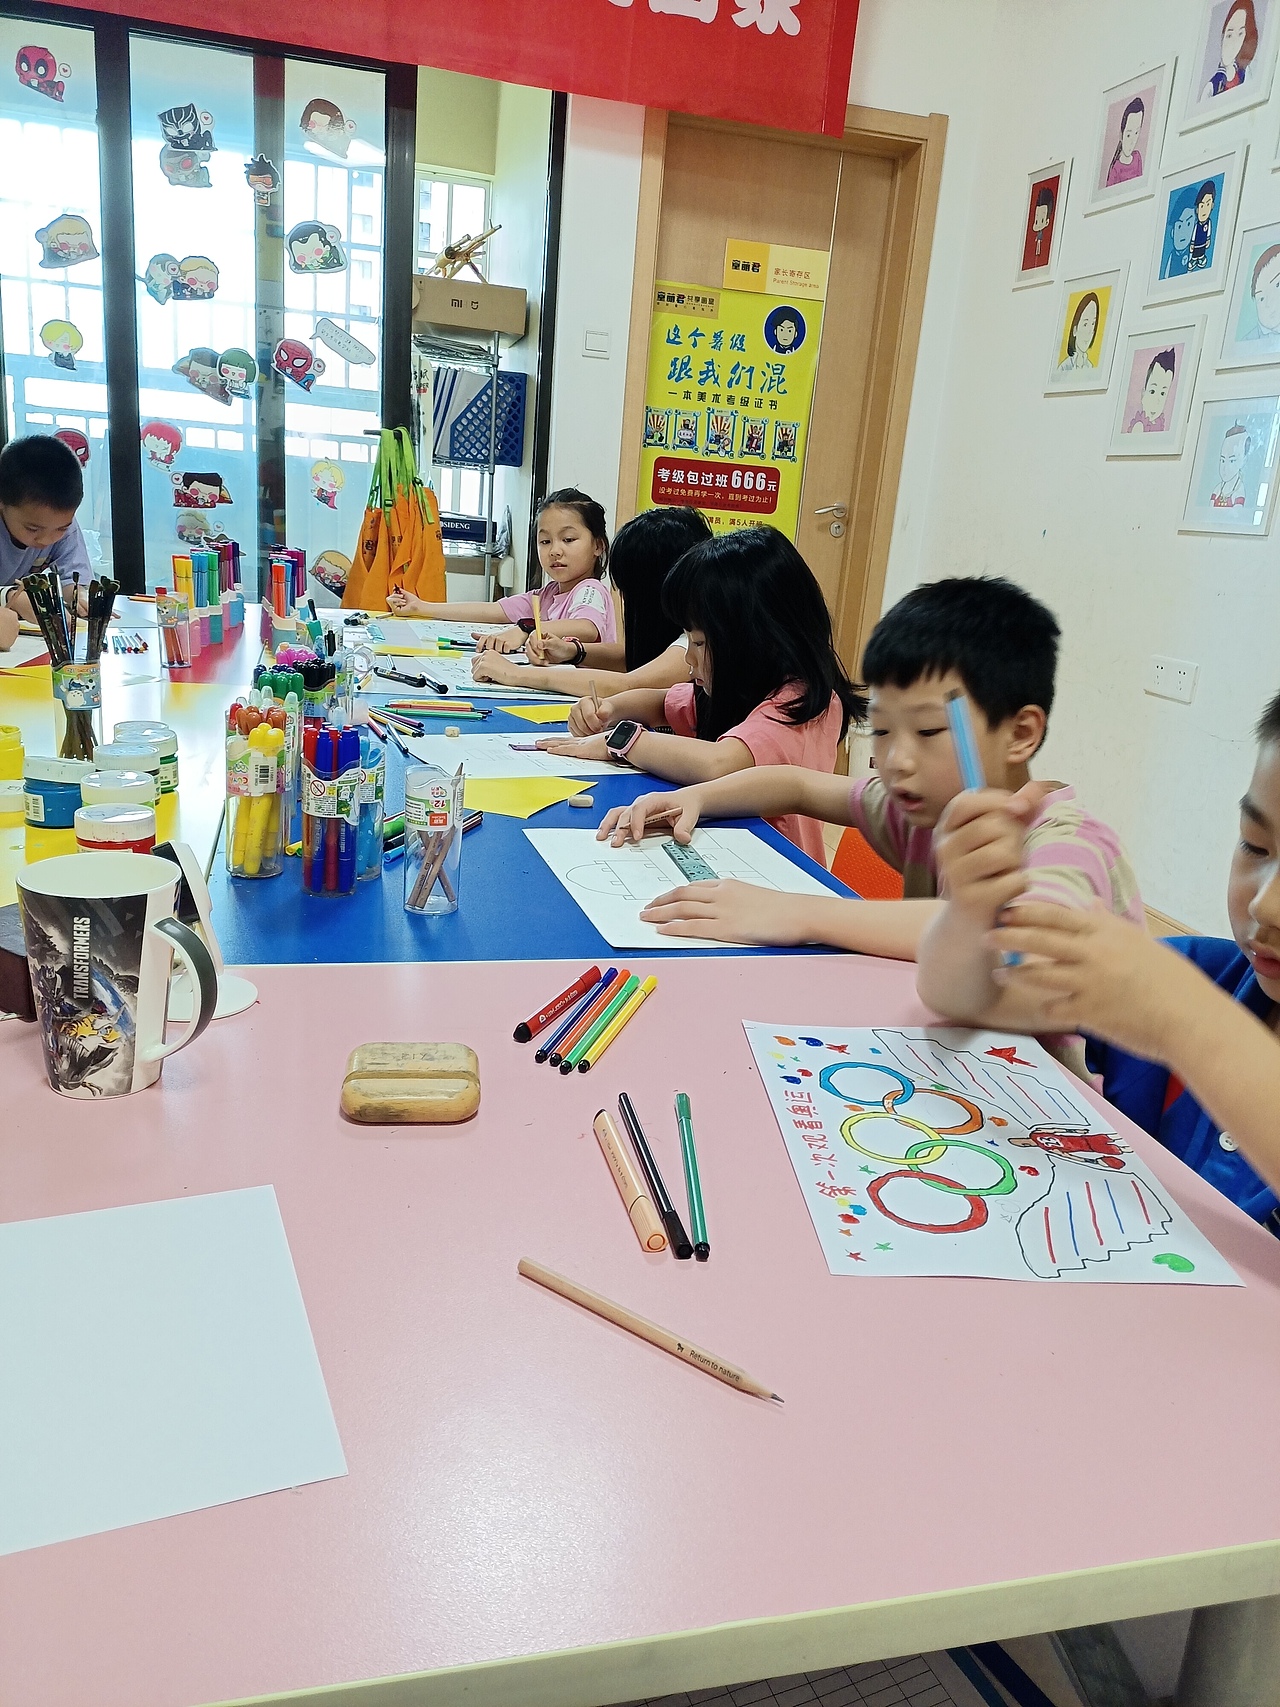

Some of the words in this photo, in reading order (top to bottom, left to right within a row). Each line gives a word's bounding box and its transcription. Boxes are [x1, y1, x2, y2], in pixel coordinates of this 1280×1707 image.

[772, 277, 789, 286] Parent
[789, 279, 808, 288] Storage
[774, 267, 811, 279] 家长寄存区
[665, 323, 747, 352] 这个暑假
[667, 355, 788, 395] 跟我们混
[667, 389, 778, 410] 一本美术考级证书
[73, 916, 91, 999] TRANSFORMERS
[689, 1350, 711, 1366] Return
[711, 1361, 719, 1371] to
[719, 1366, 740, 1382] nature
